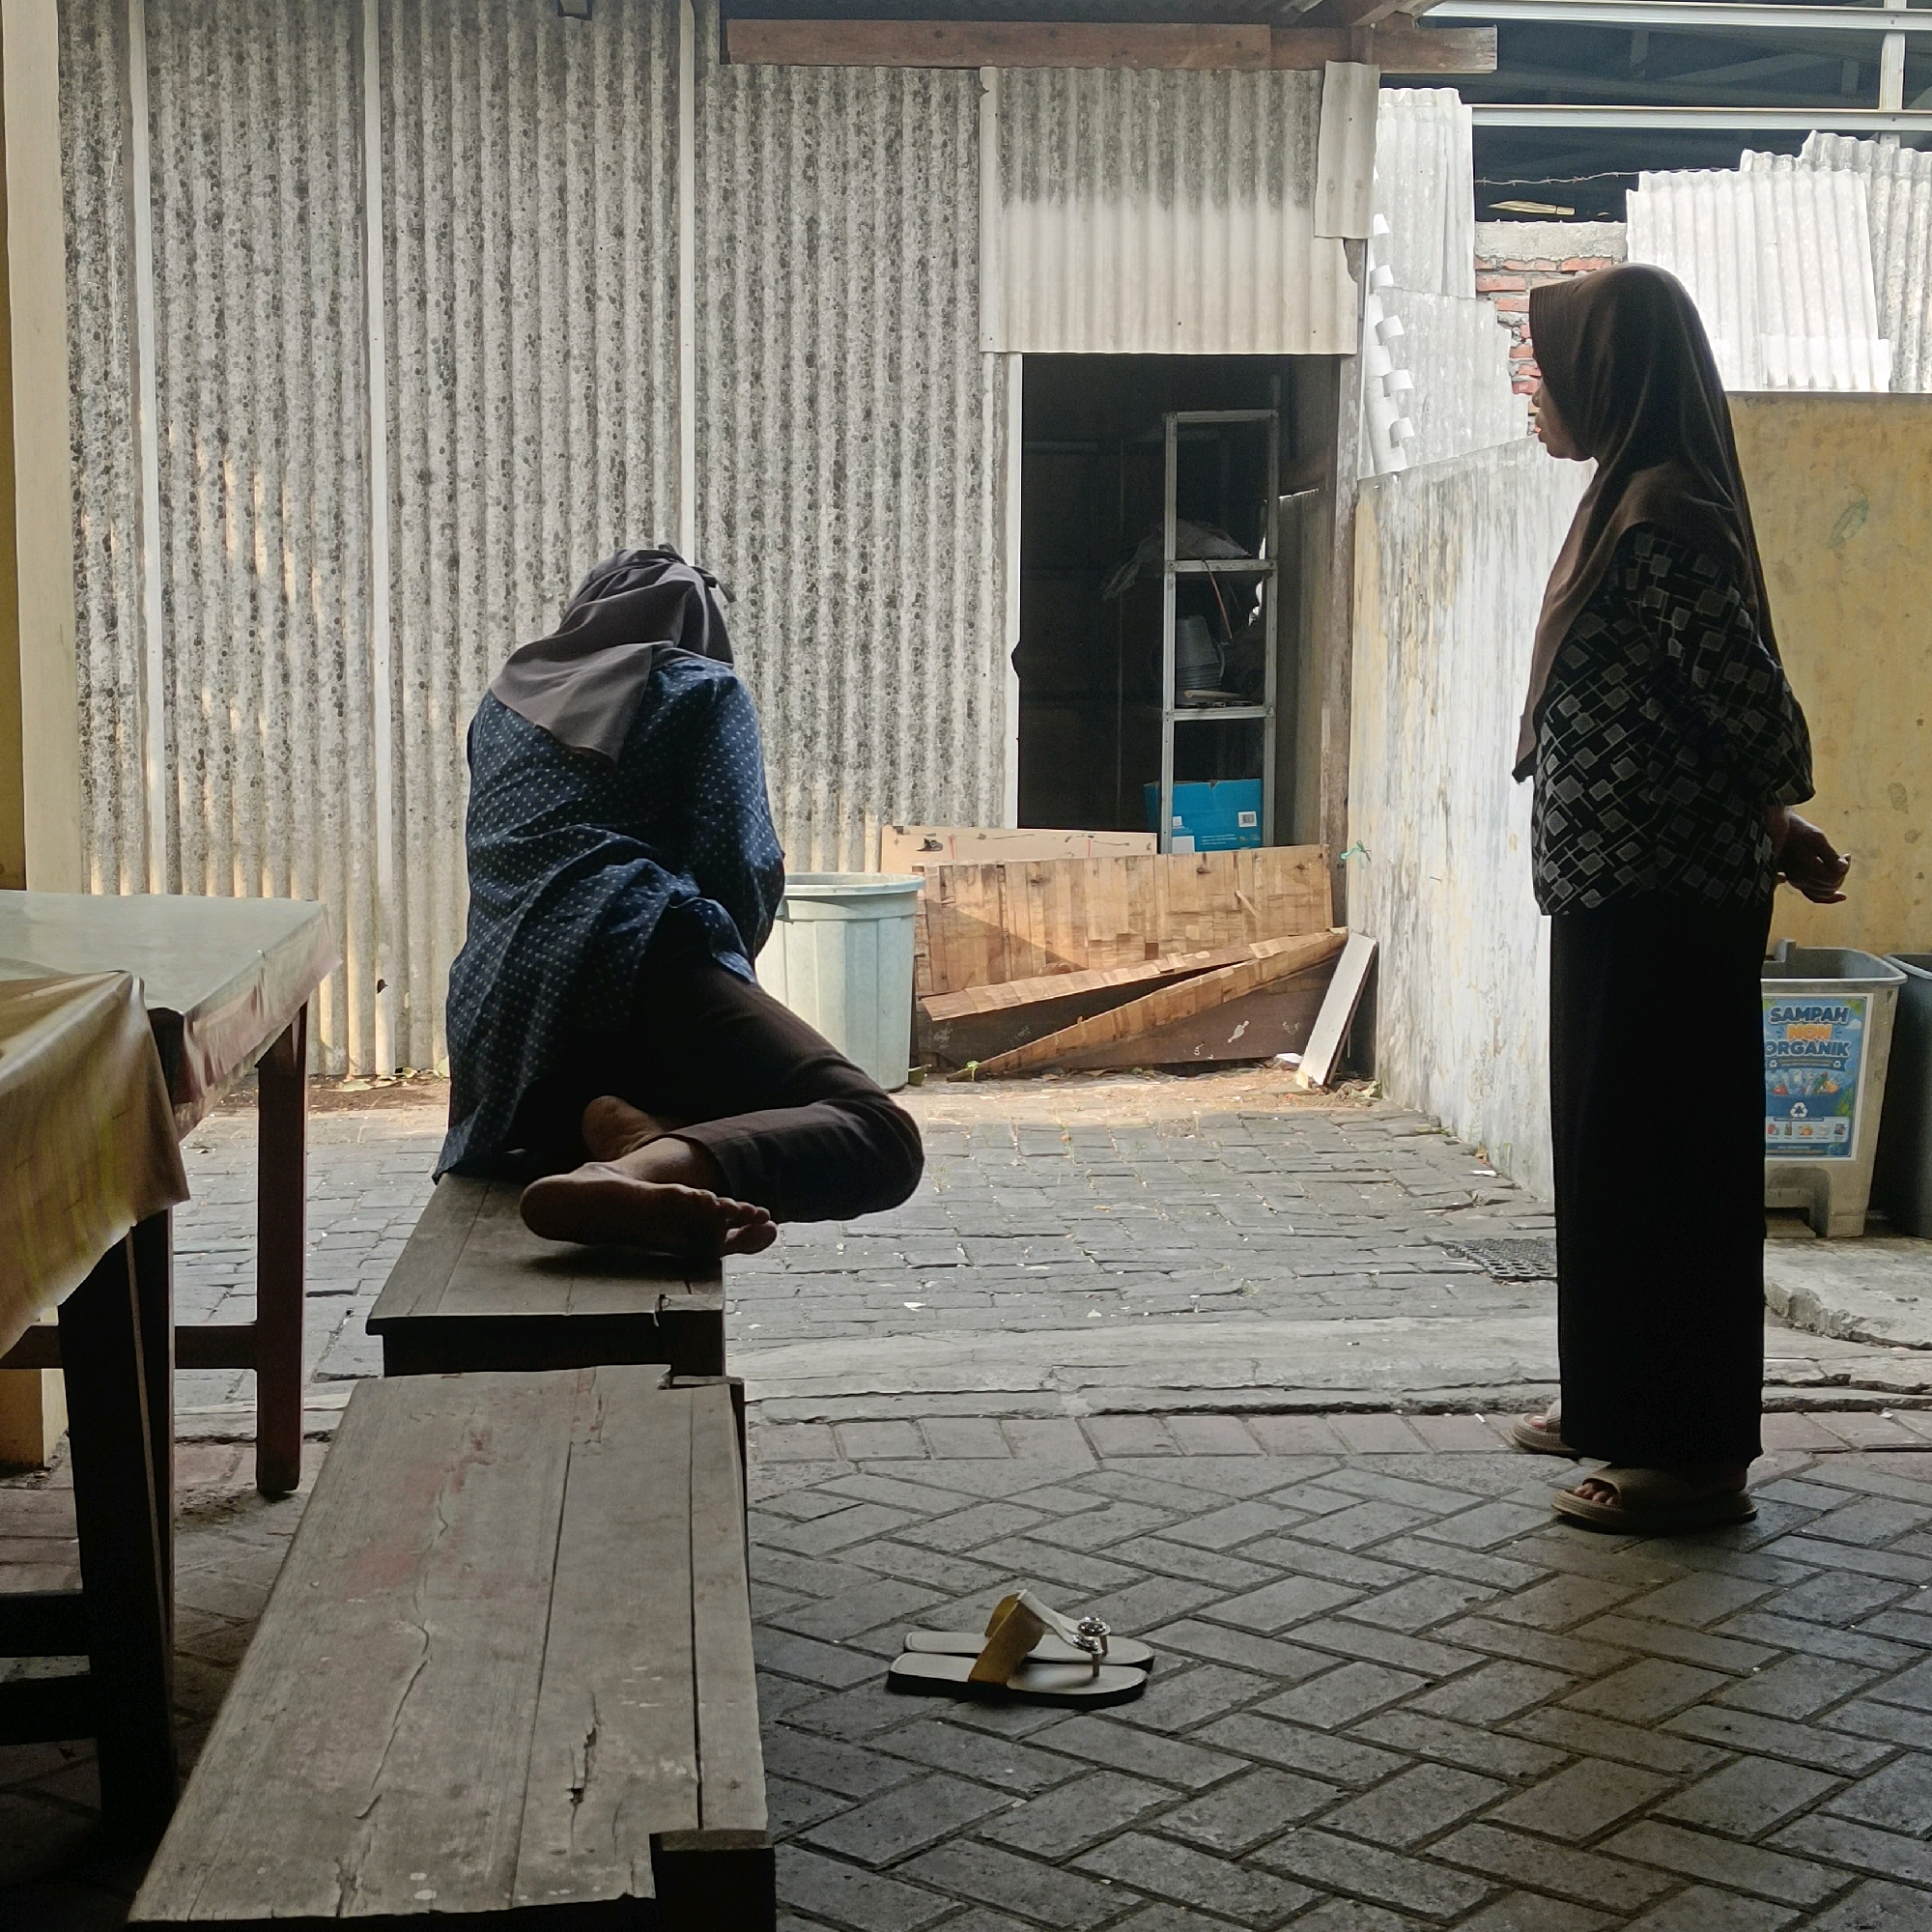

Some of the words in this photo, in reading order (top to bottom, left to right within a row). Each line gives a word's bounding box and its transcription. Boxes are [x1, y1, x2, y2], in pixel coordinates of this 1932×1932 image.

[1770, 1007, 1850, 1023] SAMPAH
[1787, 1024, 1833, 1040] NON
[1766, 1040, 1850, 1057] ORGANIK
